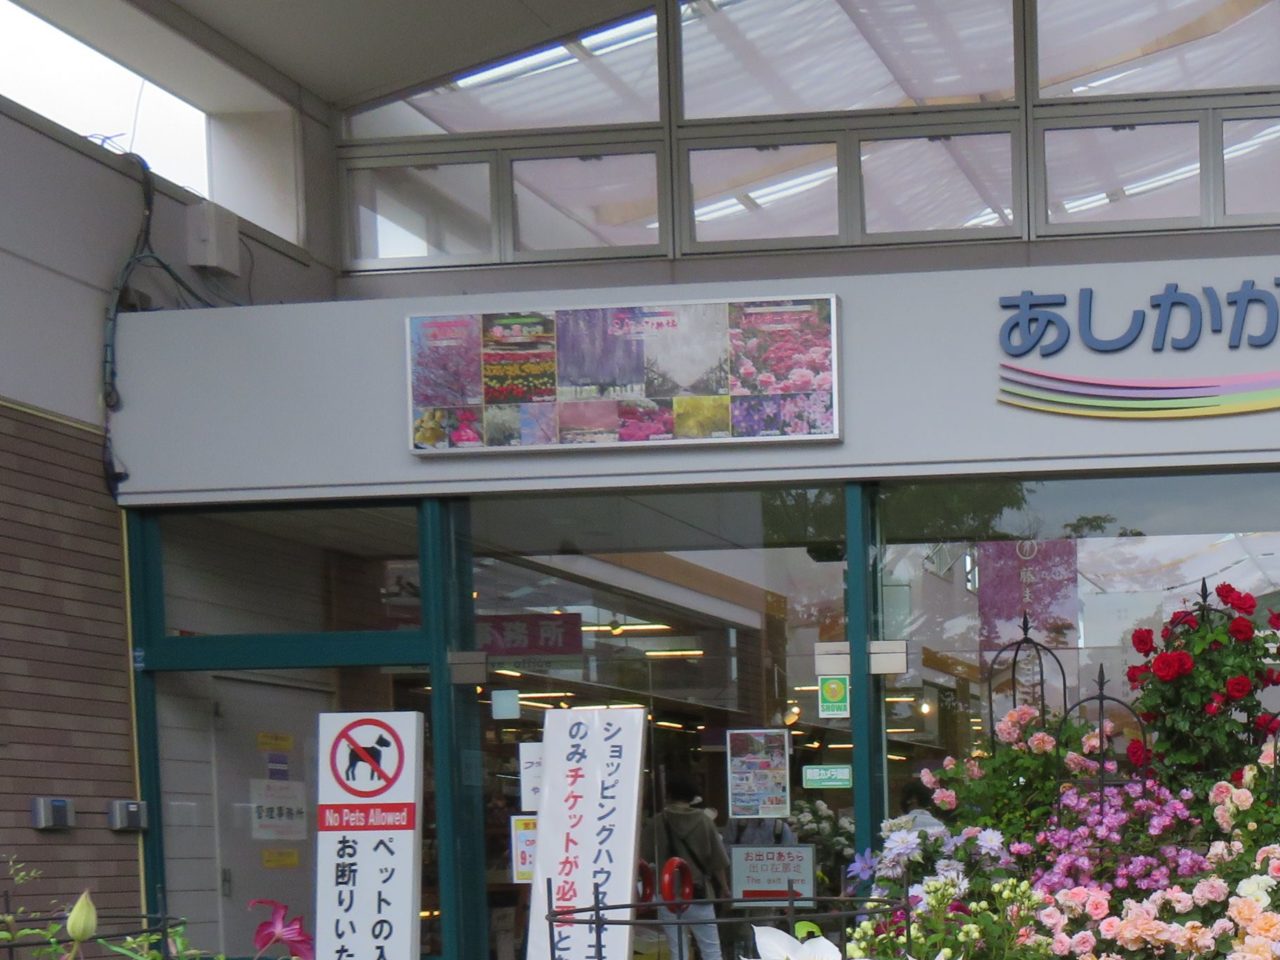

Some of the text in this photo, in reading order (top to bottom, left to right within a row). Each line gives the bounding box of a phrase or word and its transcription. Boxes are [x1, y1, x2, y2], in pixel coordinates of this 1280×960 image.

[325, 808, 408, 826] No Pets Allowed
